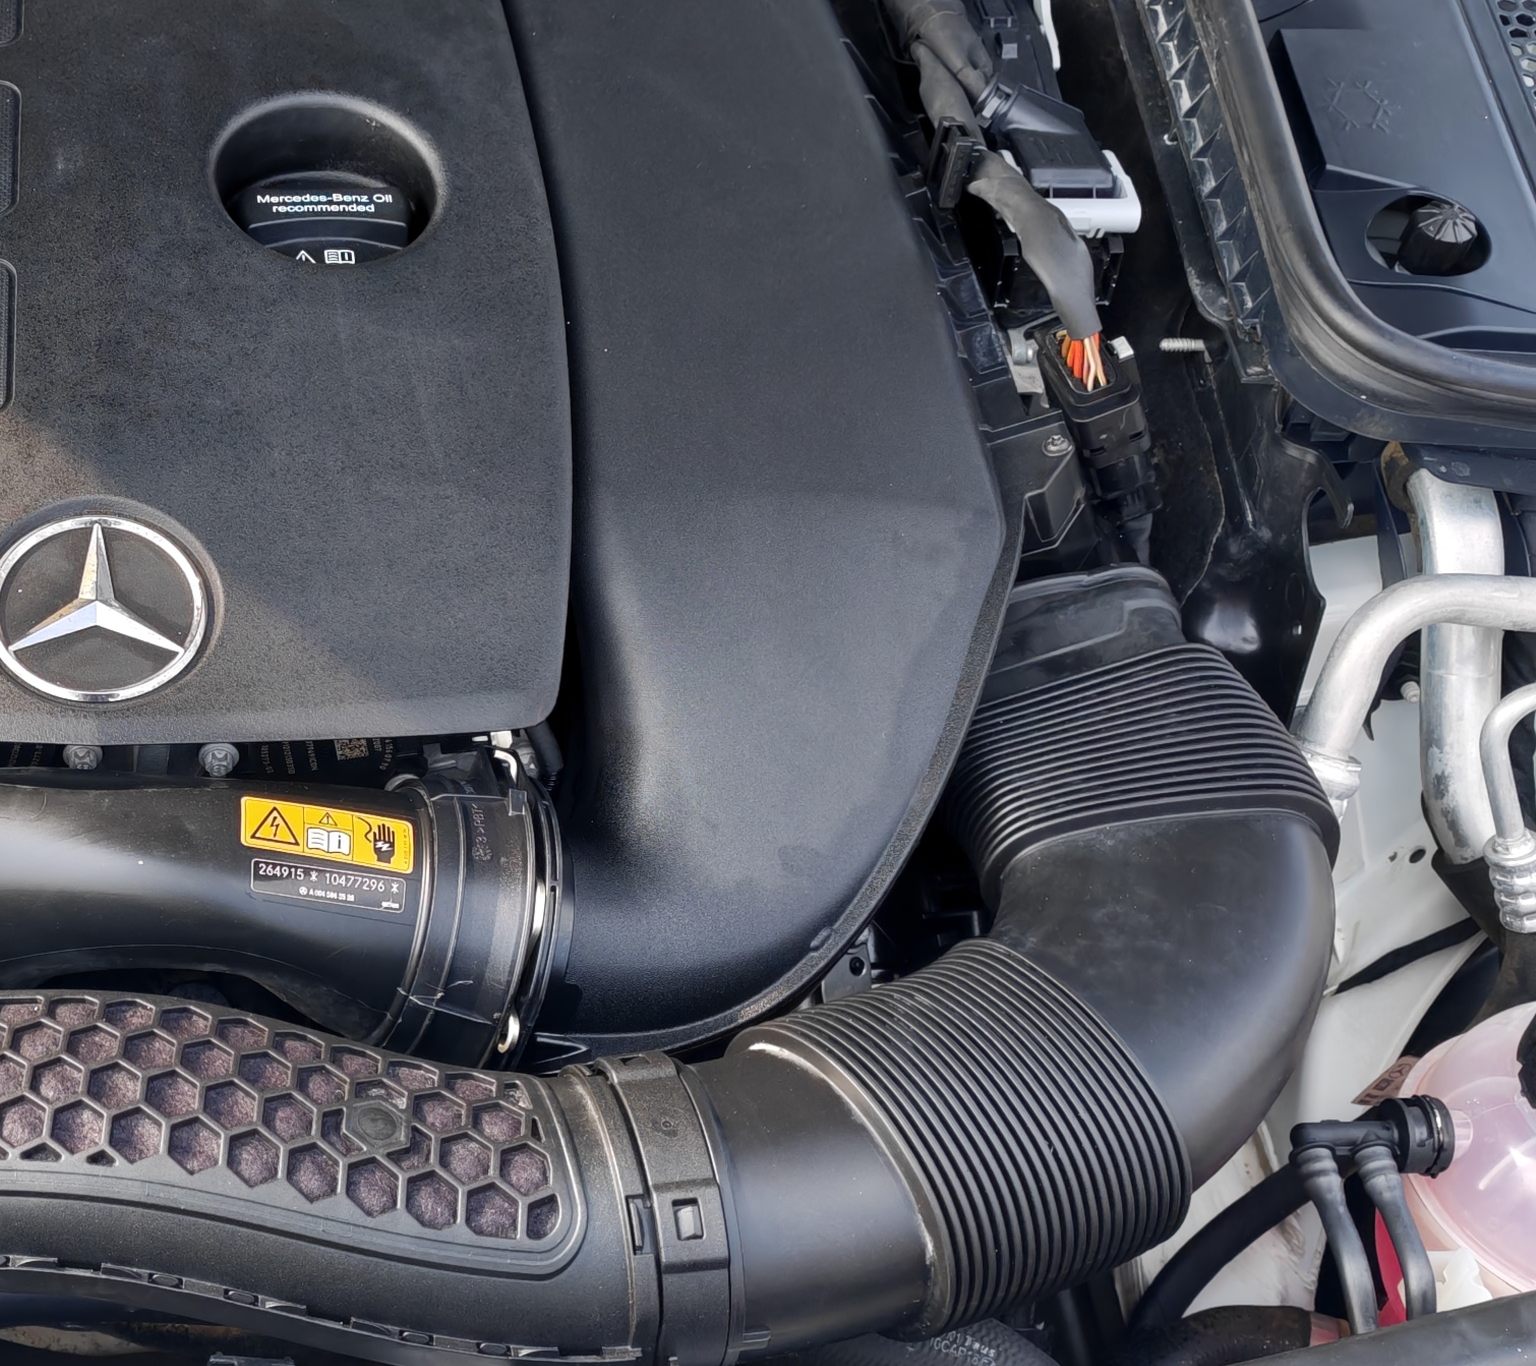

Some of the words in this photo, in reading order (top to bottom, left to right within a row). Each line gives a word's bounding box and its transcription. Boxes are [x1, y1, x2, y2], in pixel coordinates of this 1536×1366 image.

[256, 193, 370, 204] Mercedes-Benz
[372, 193, 393, 204] Oil
[272, 203, 375, 213] recommended
[258, 863, 305, 880] 264915
[324, 873, 386, 892] 10477296
